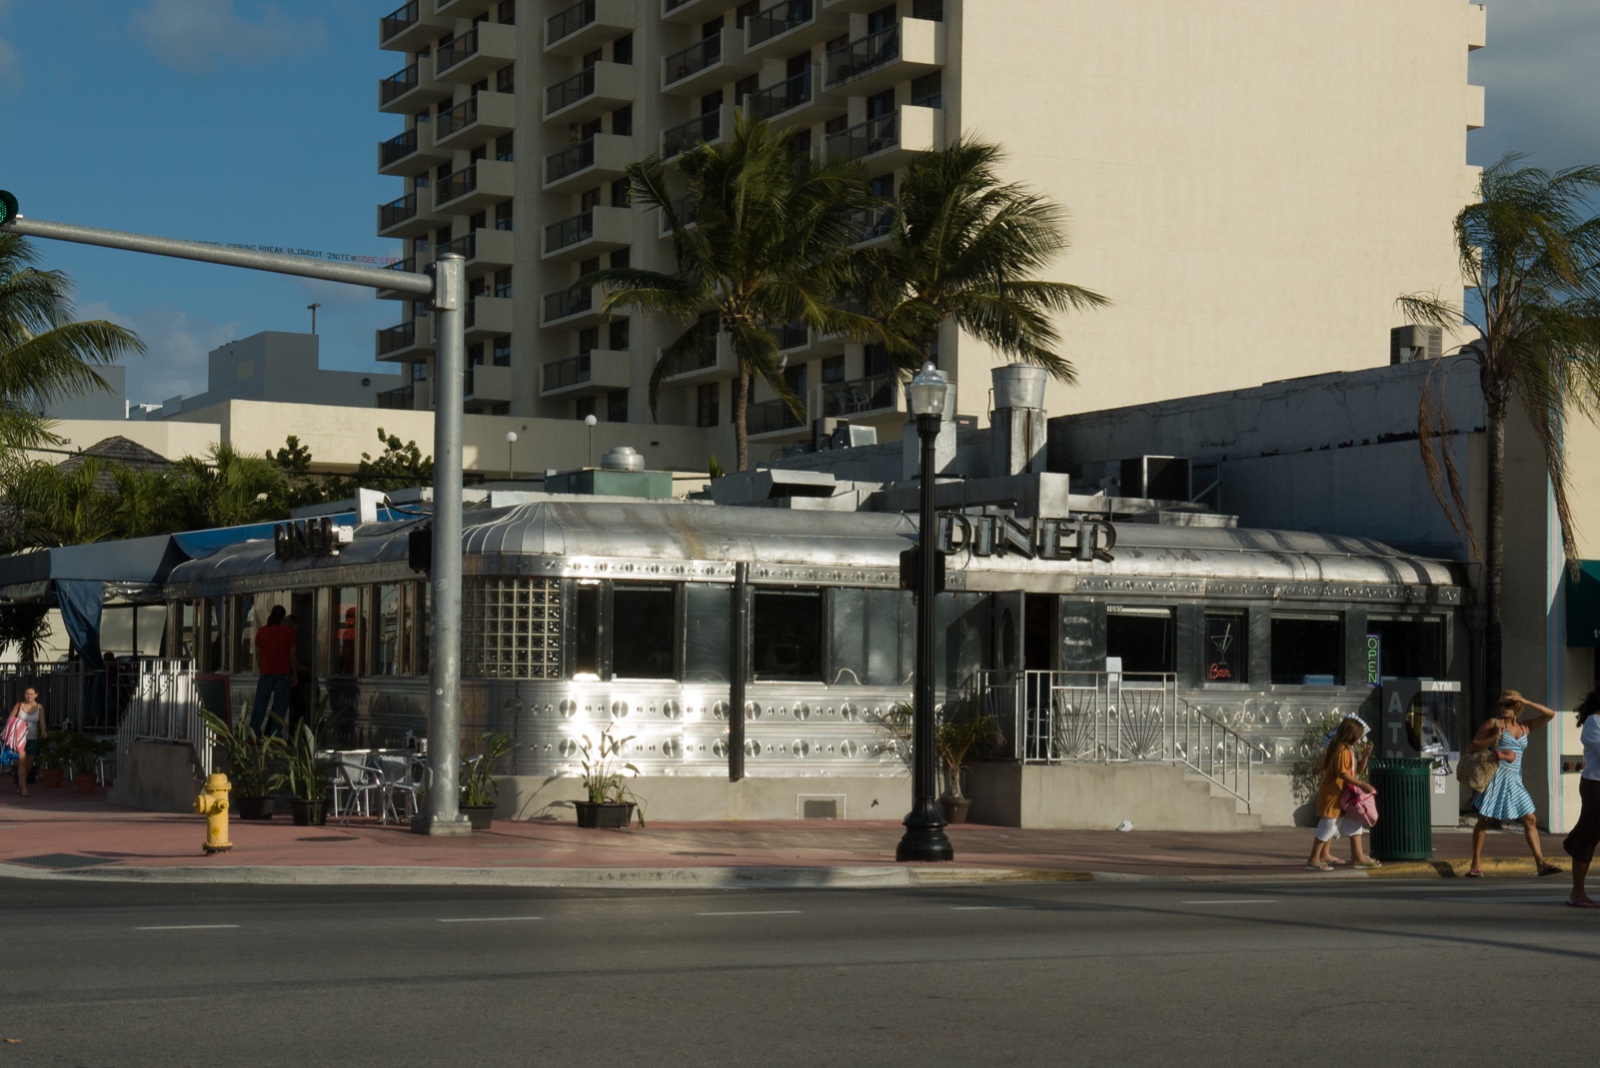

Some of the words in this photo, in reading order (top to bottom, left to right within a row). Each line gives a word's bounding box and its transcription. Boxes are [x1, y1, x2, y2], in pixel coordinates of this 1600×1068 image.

[259, 245, 284, 254] BREAK
[287, 247, 323, 258] BLOWOUT
[935, 511, 1116, 562] DINER
[1367, 637, 1378, 684] OPEN
[1209, 662, 1232, 680] Bar
[1431, 682, 1453, 692] ATM
